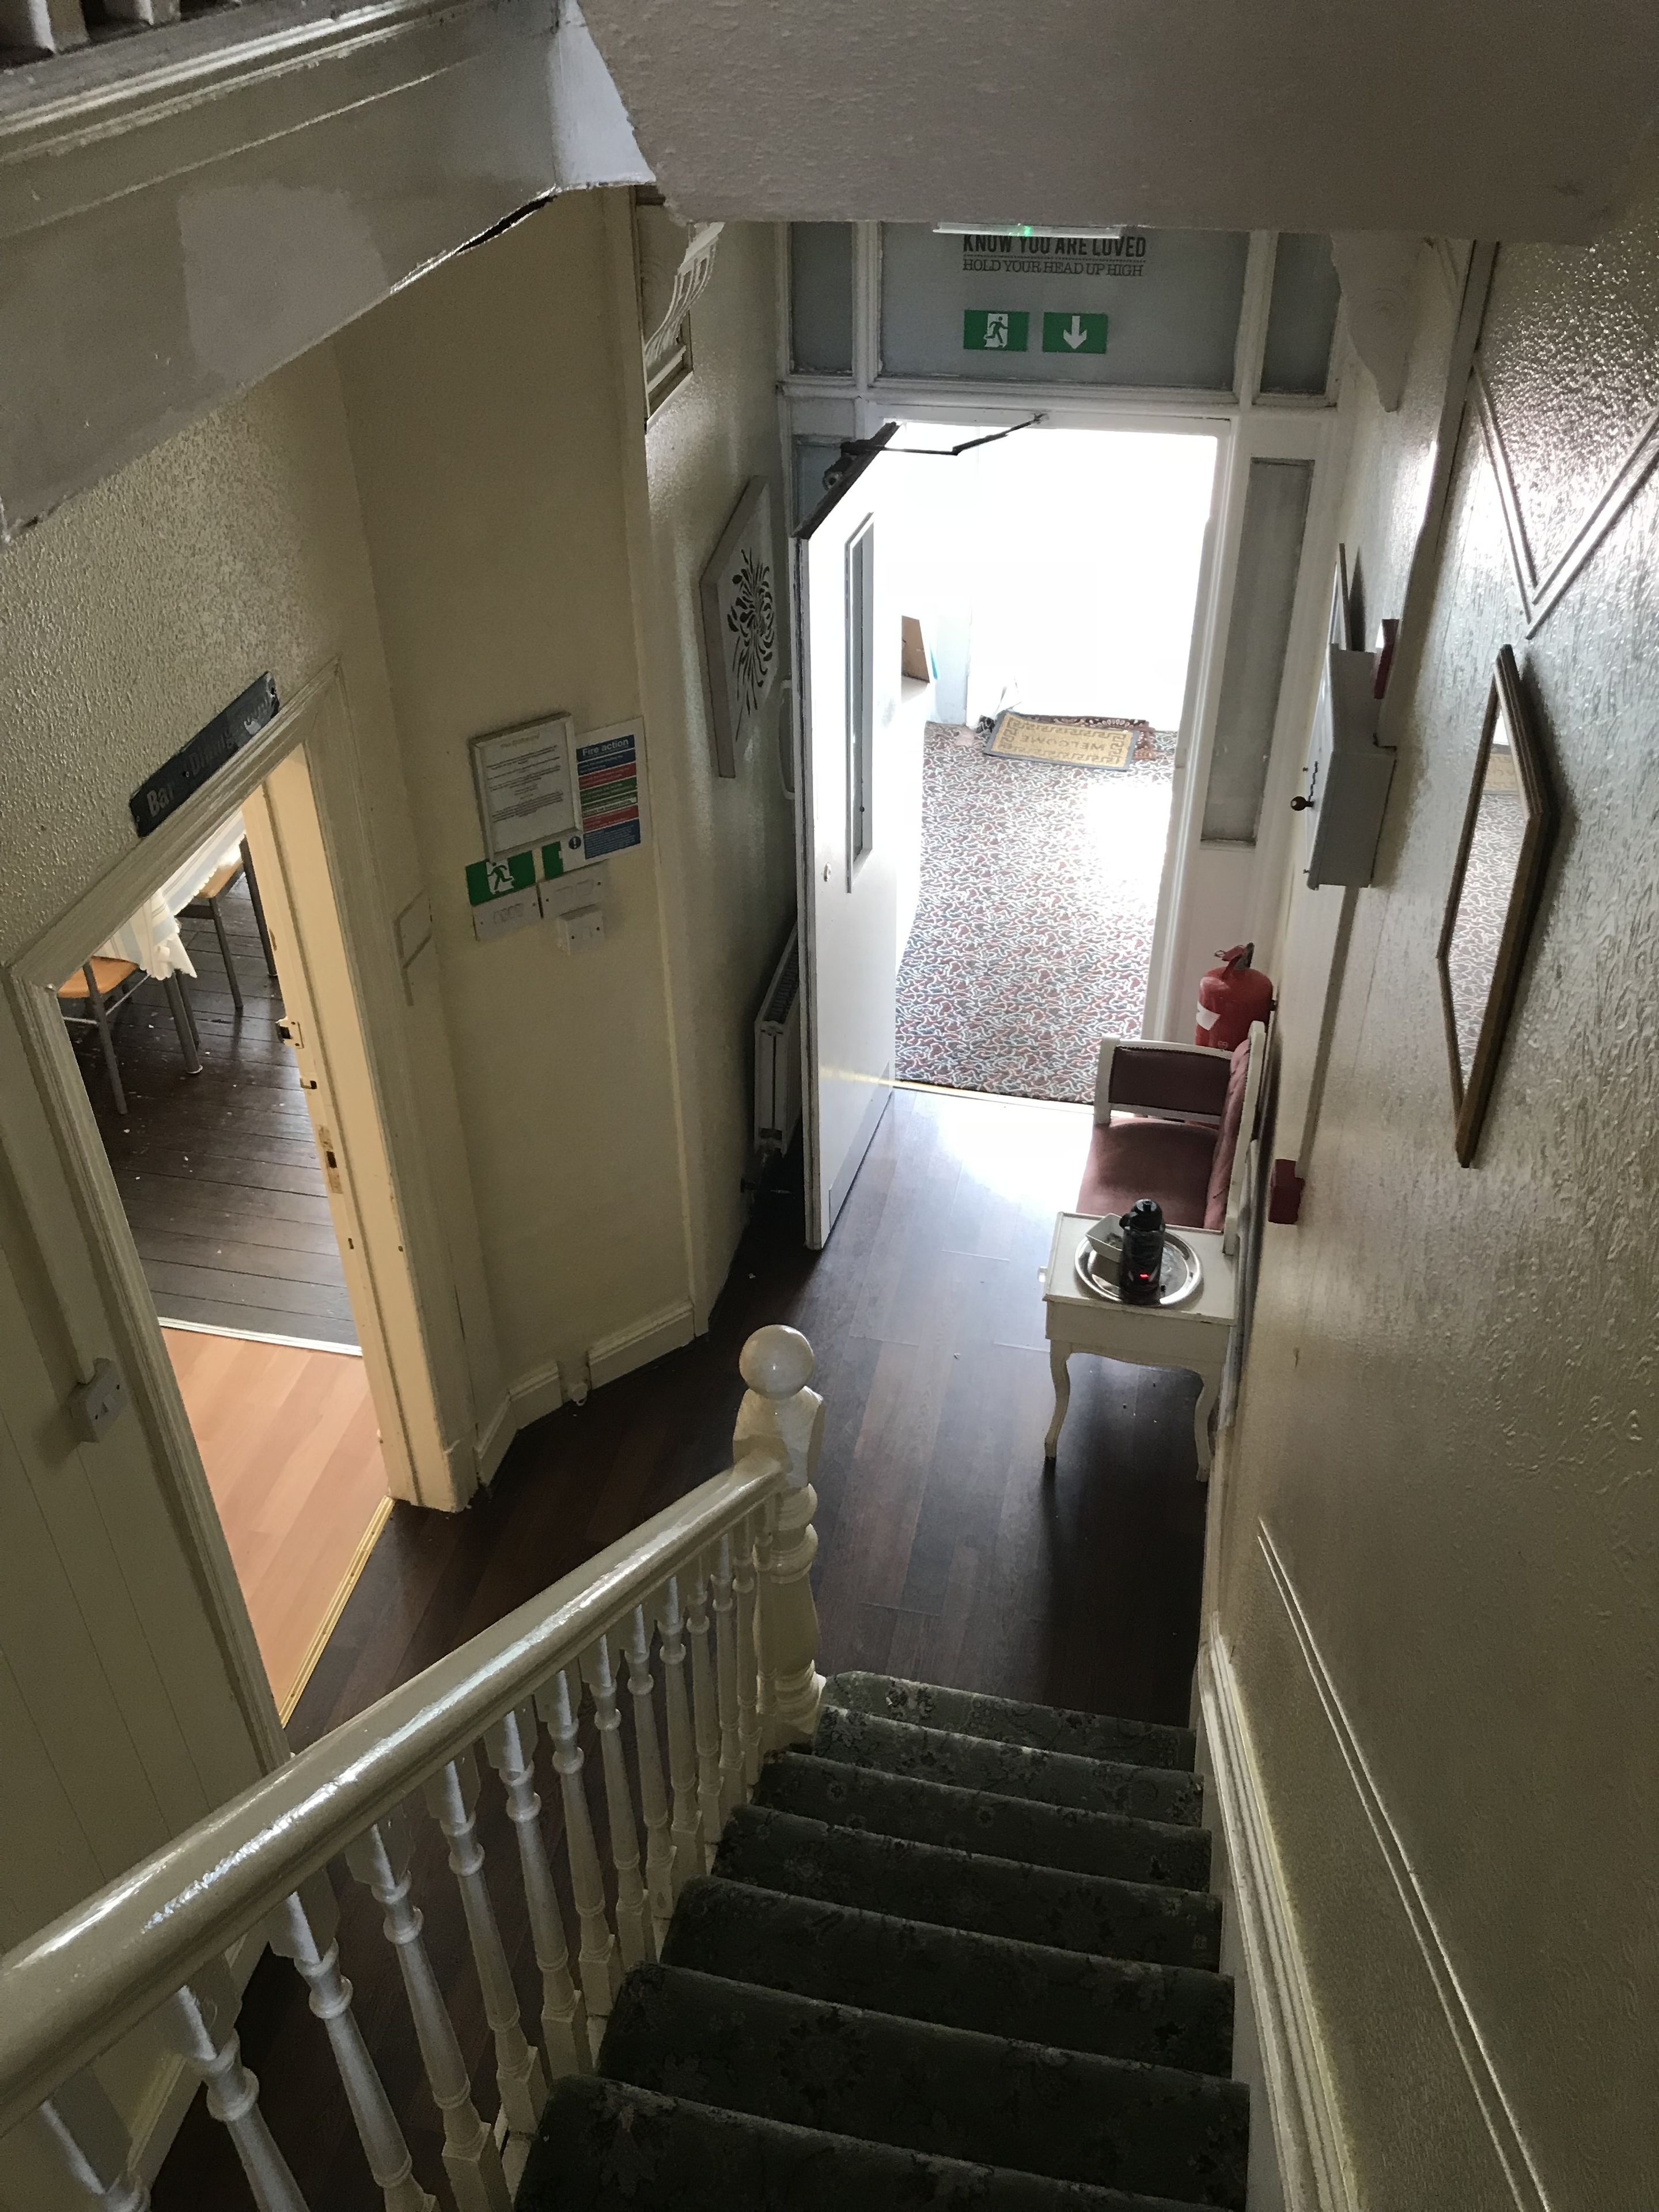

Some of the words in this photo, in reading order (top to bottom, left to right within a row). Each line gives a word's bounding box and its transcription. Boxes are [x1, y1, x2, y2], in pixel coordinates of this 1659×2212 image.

[963, 234, 1012, 252] KNOW
[1020, 236, 1050, 254] YOU
[1055, 237, 1087, 255] ARE
[1092, 236, 1146, 257] LOVED
[963, 258, 1001, 271] HOLD
[1003, 260, 1041, 273] YOUR
[1043, 261, 1084, 274] HEAD
[1086, 263, 1105, 275] UP
[1106, 264, 1144, 277] HIGH
[582, 747, 599, 756] Fire
[601, 738, 629, 751] action
[1020, 735, 1105, 751] WELCOME
[146, 785, 172, 817] Bar
